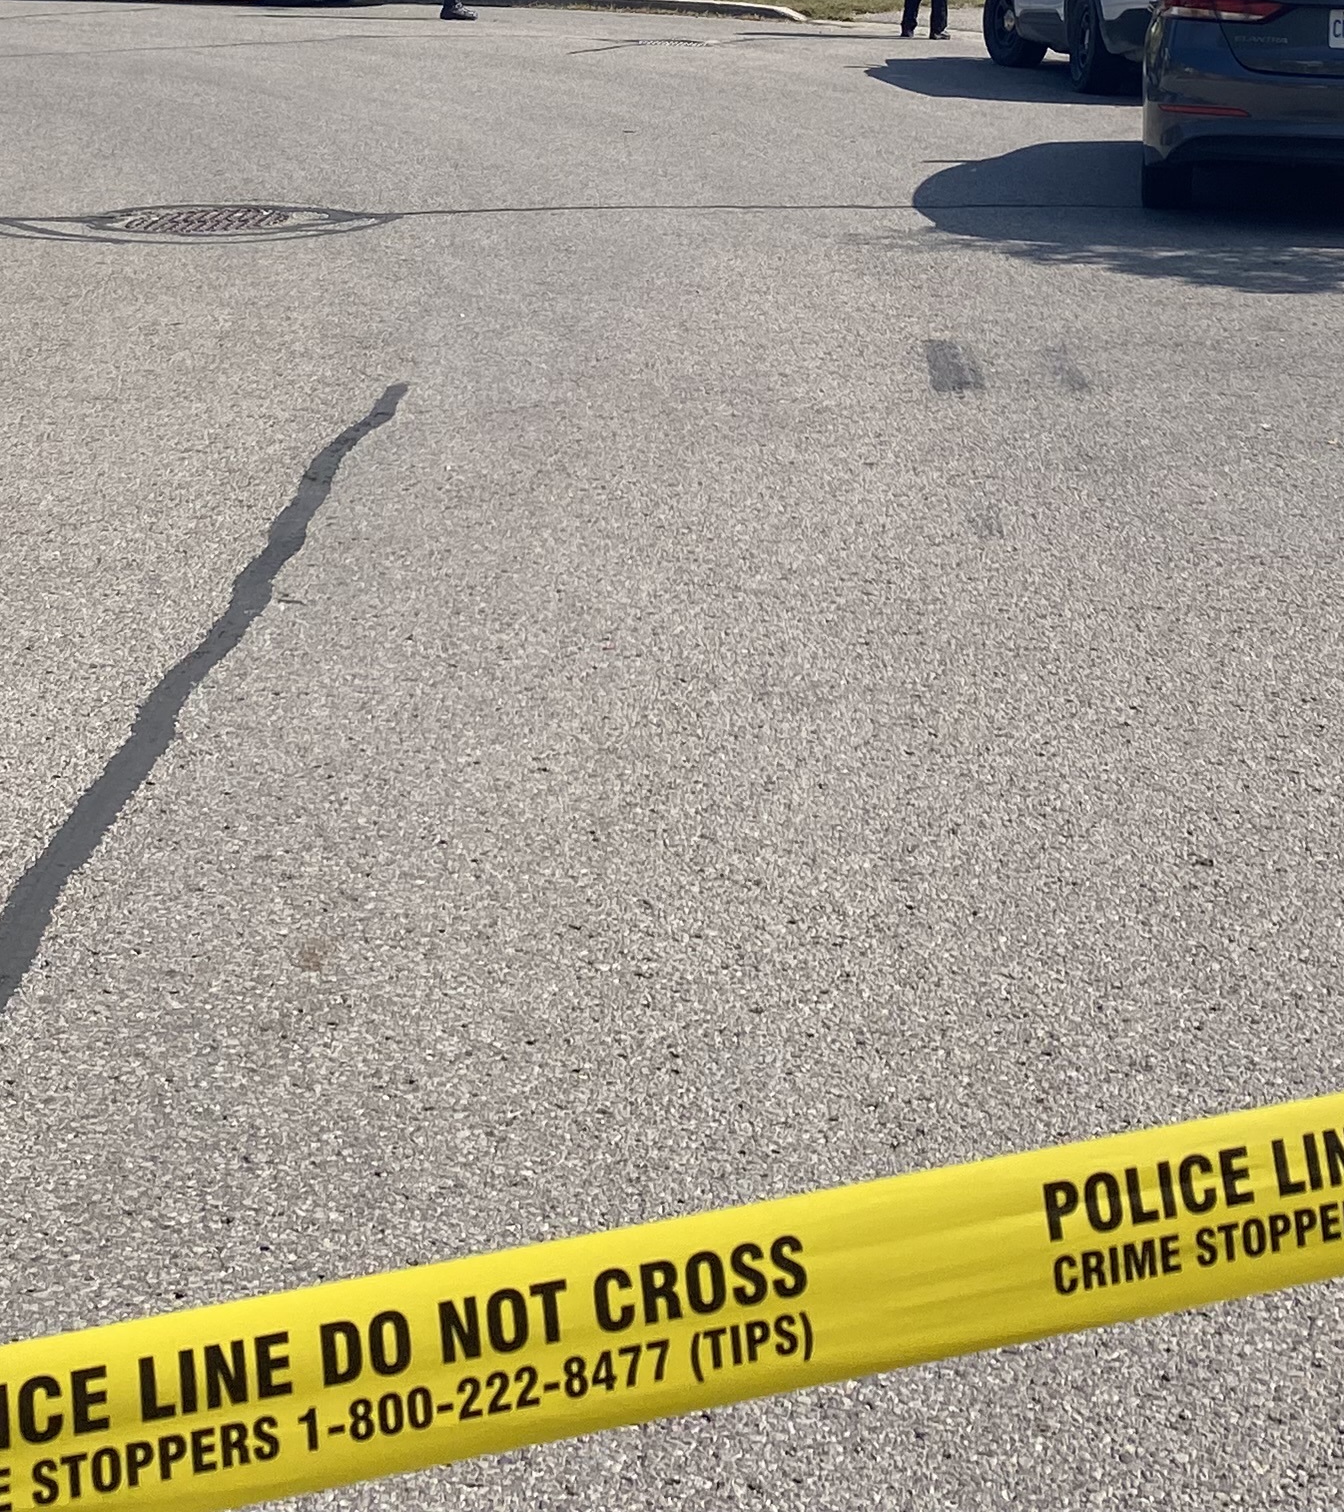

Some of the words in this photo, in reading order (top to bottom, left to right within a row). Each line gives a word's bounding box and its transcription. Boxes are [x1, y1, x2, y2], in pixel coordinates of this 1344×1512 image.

[1043, 1146, 1255, 1242] POLICE
[1053, 1234, 1182, 1296] CRIME
[138, 1331, 293, 1423] LINE
[320, 1310, 411, 1388] DO
[438, 1279, 567, 1365] NOT
[593, 1235, 807, 1333] CROSS
[31, 1416, 280, 1506] STOPPERS
[298, 1332, 669, 1452] 1-800-222-8477
[690, 1310, 813, 1383] (TIPS)
